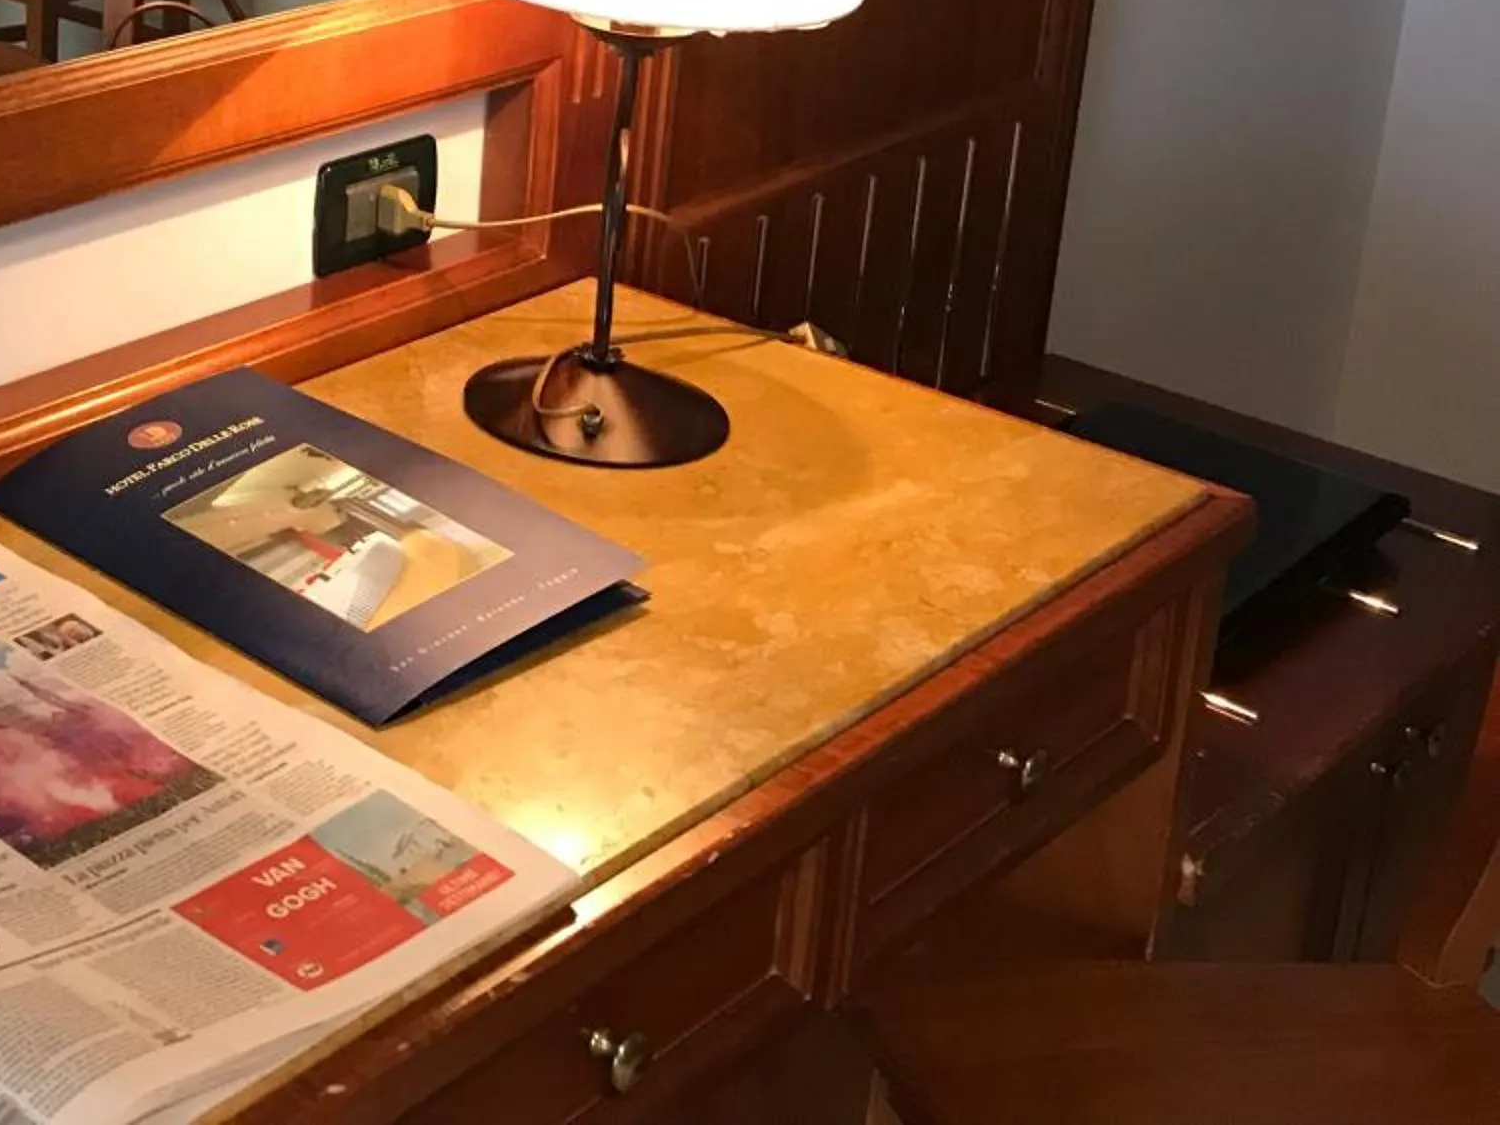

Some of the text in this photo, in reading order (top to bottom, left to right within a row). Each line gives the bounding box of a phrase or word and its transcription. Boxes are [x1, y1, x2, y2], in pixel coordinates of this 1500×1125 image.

[103, 467, 150, 497] HOTEL
[252, 856, 308, 890] VAN
[265, 876, 339, 920] GOGH
